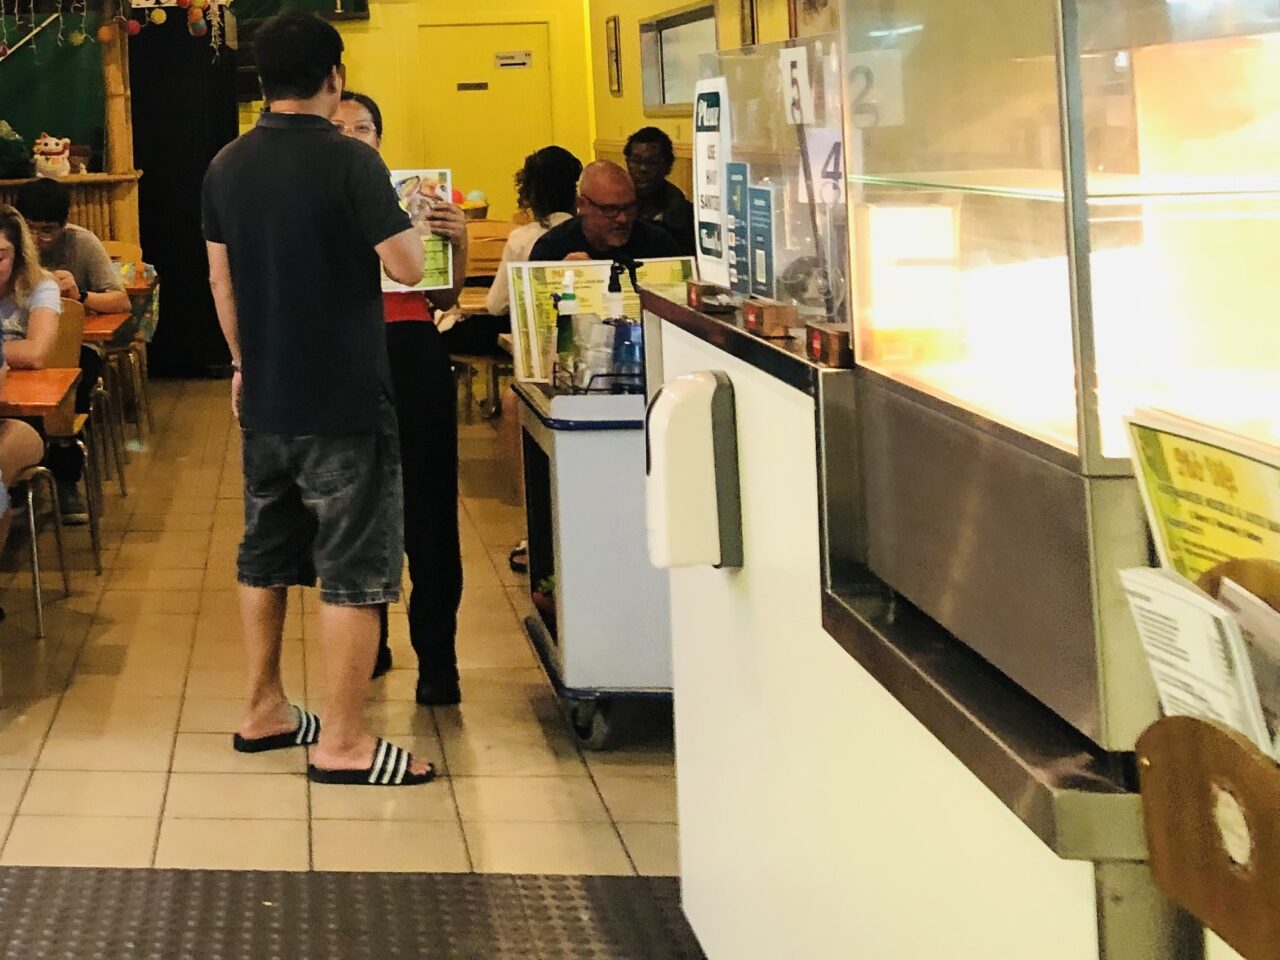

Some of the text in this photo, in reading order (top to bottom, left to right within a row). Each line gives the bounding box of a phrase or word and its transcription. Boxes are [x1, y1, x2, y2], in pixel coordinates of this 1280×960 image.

[790, 60, 801, 111] 5
[850, 65, 875, 114] 2
[821, 141, 842, 189] 4
